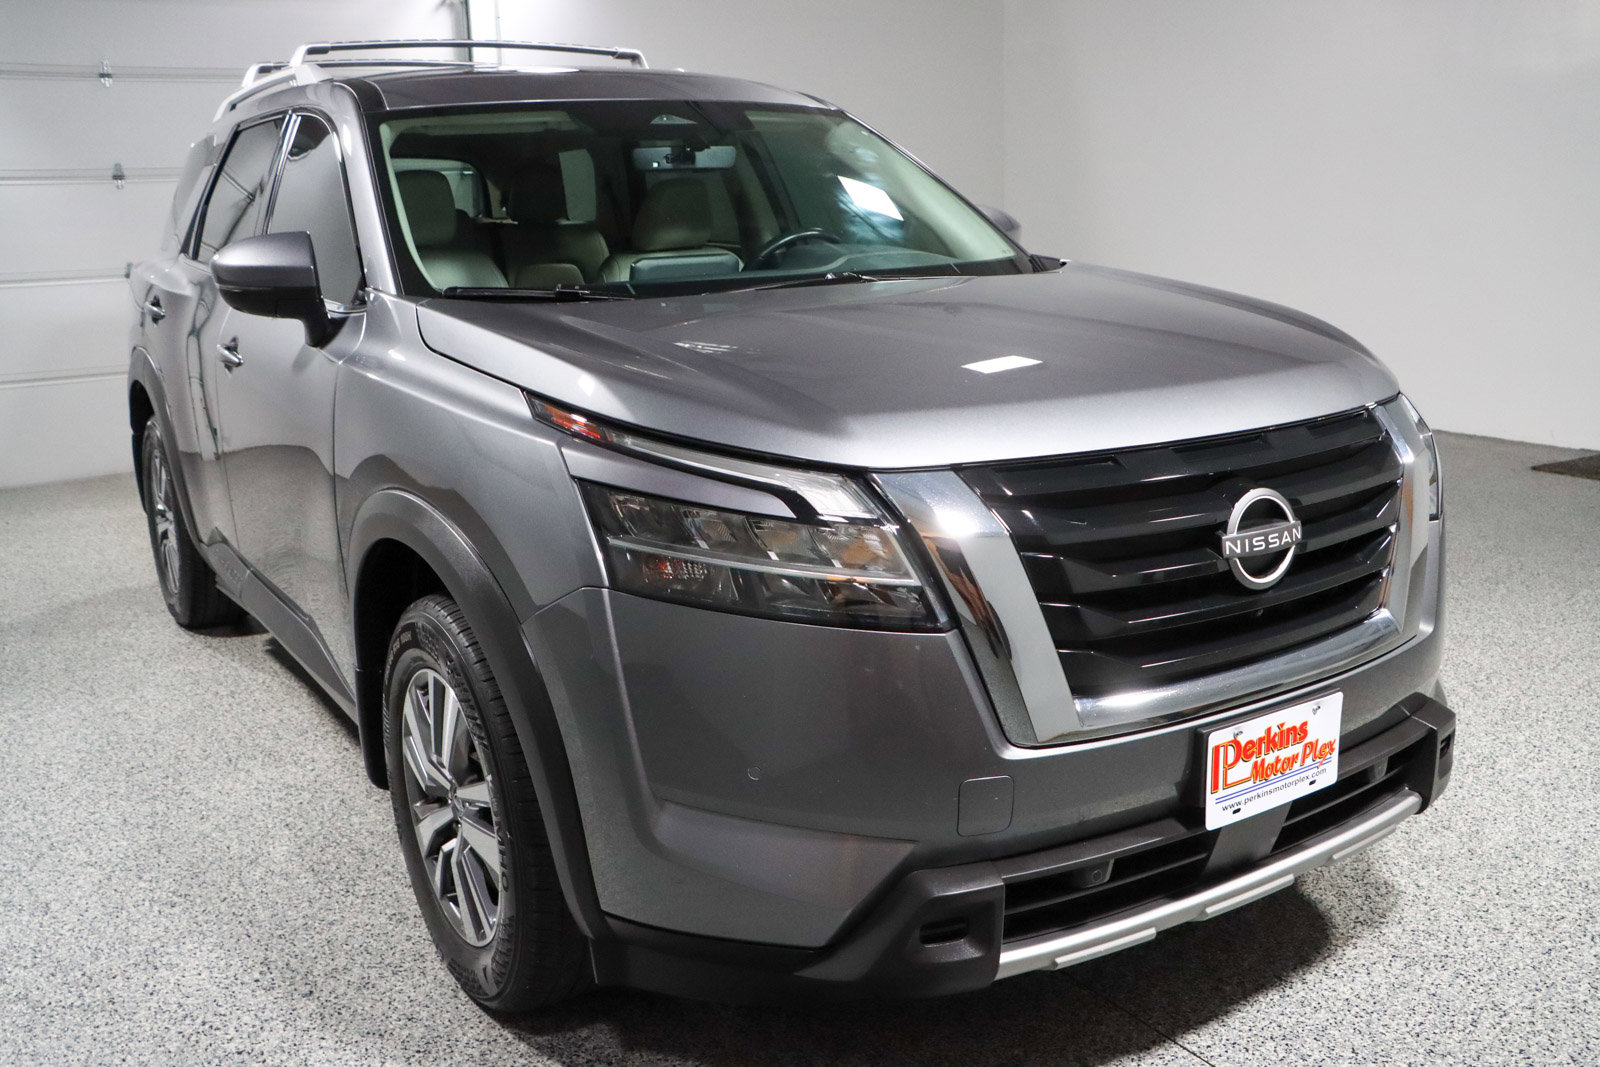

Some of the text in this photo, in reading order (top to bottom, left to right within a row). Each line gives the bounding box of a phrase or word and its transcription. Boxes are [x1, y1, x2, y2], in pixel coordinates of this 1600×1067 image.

[1225, 525, 1301, 555] NISSAN
[1211, 720, 1309, 794] Perkins
[1249, 738, 1337, 784] Motor Plex
[1221, 768, 1327, 812] www.perkinsmotorplex.com
